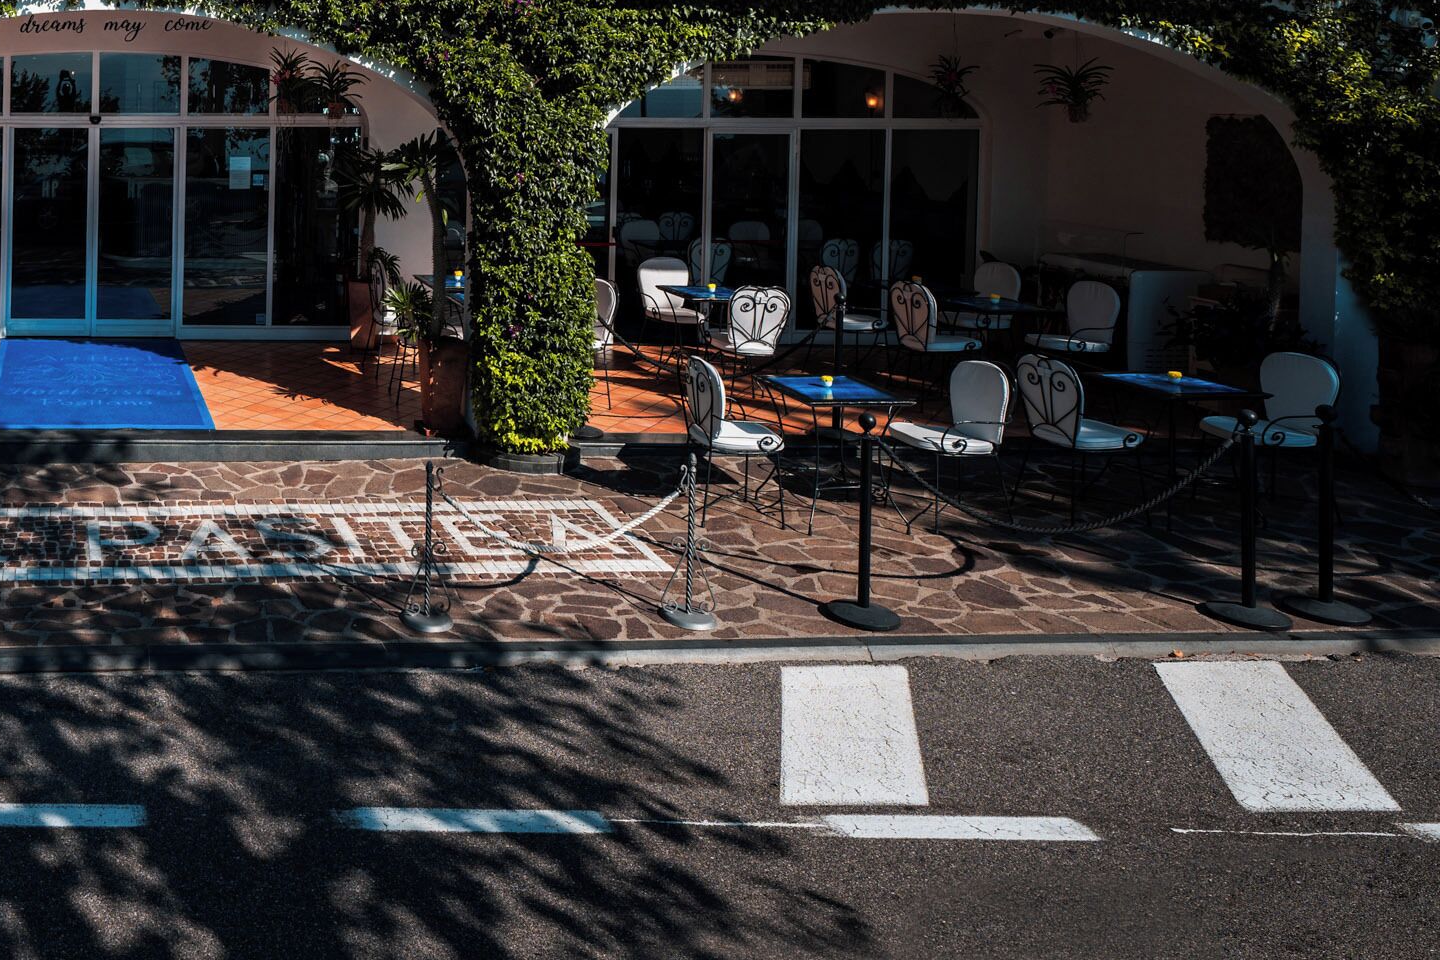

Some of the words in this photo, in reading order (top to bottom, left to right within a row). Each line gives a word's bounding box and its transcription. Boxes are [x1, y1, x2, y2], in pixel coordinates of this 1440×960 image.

[20, 14, 87, 34] dreams
[104, 19, 146, 42] may
[164, 17, 213, 32] come
[41, 178, 60, 199] HP
[86, 515, 630, 561] PASITEA
